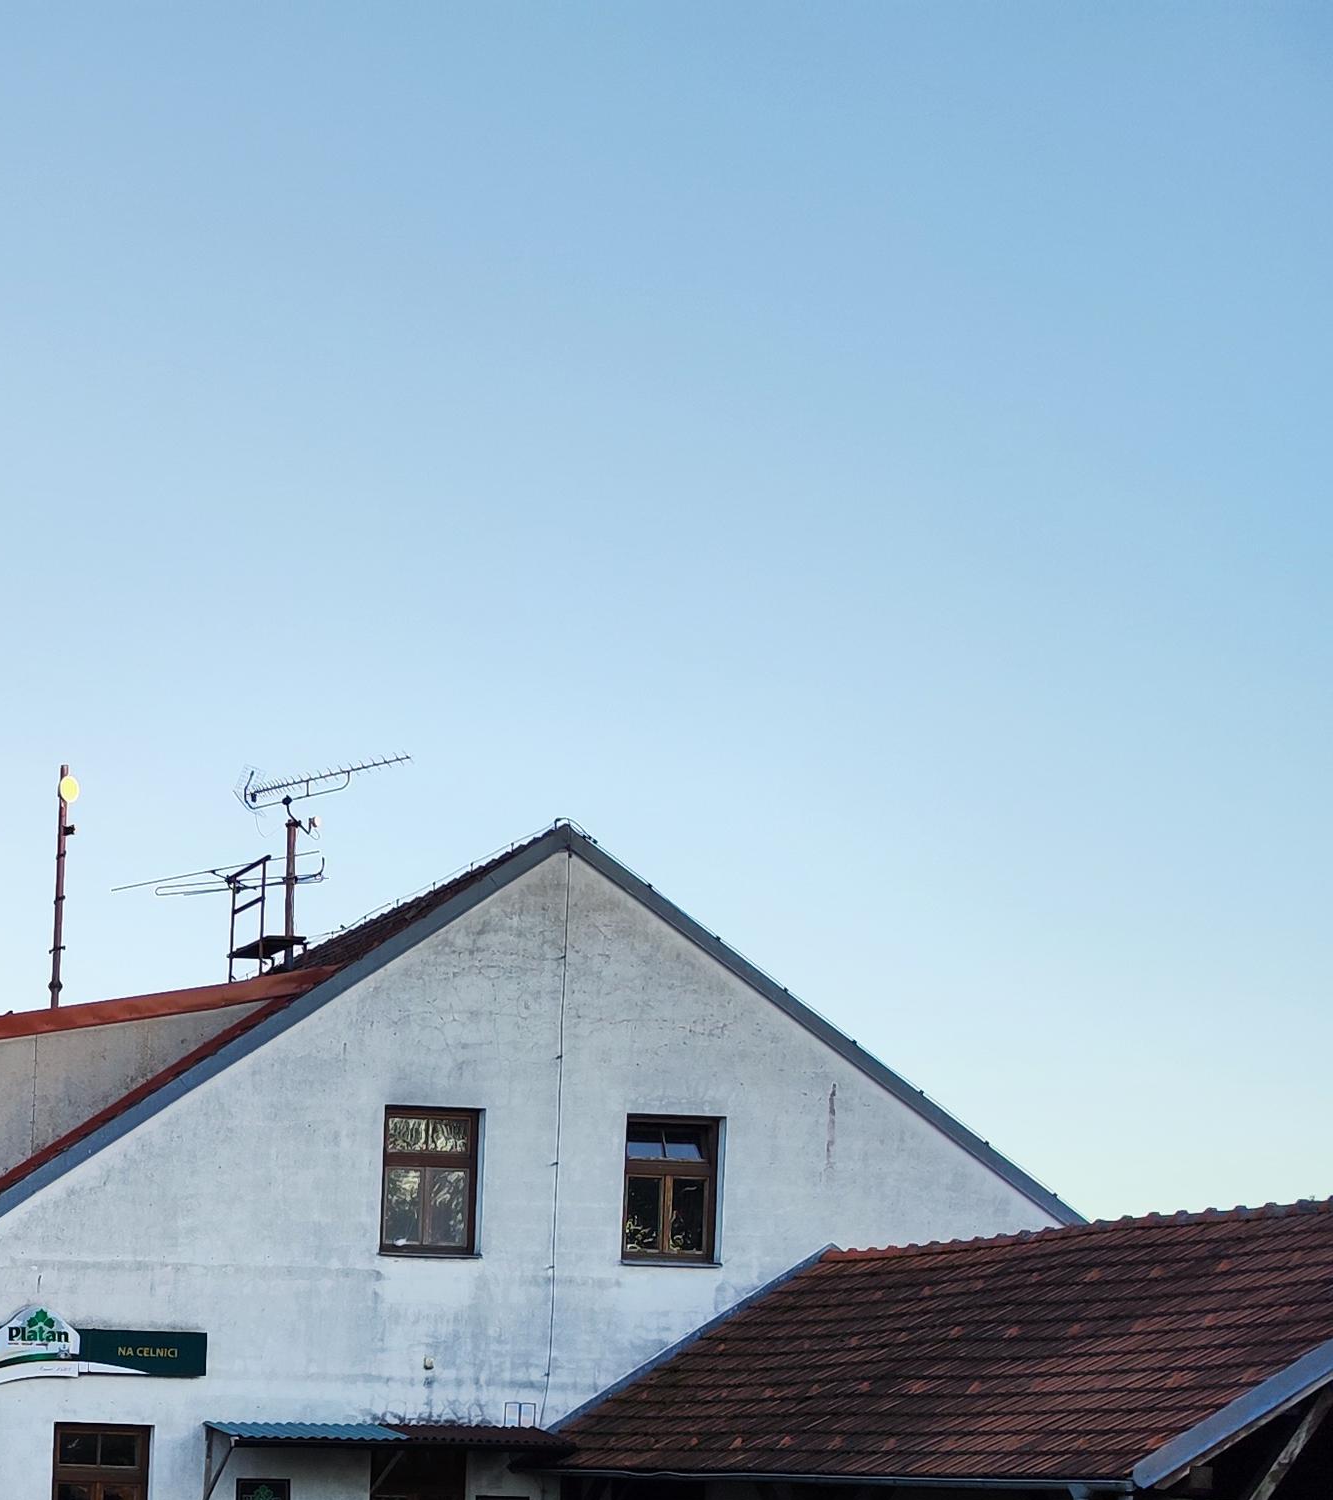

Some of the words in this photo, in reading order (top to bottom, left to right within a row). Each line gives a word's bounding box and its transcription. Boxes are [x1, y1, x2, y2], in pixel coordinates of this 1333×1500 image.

[7, 1326, 70, 1343] Platan
[117, 1346, 134, 1357] NA
[136, 1347, 178, 1358] CELNICI
